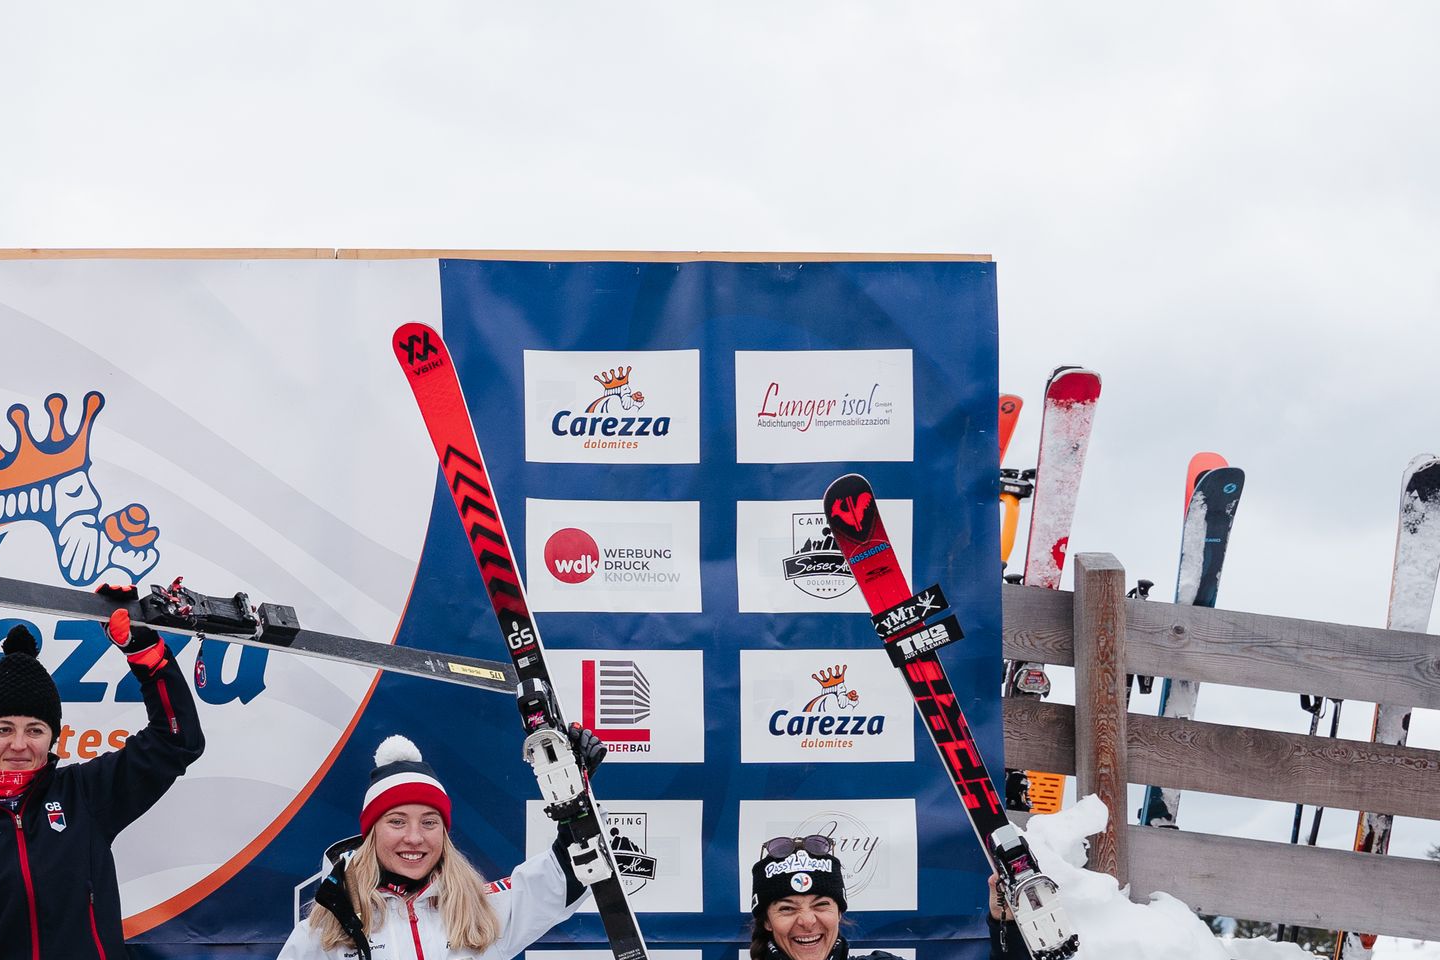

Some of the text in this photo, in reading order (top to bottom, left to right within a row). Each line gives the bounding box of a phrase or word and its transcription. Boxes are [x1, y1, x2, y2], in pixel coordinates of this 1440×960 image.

[758, 382, 836, 433] Lunger
[842, 383, 880, 415] isol
[551, 410, 671, 438] Carezza
[757, 417, 891, 429] Abdichtungen Impermeabilizzazioni
[584, 440, 639, 449] dolomites
[603, 549, 672, 559] WERBUNG
[848, 542, 891, 565] ROSSIGNOL
[554, 555, 600, 575] wdk
[603, 561, 650, 571] DRUCK
[603, 572, 681, 583] KNOWHOW
[806, 579, 846, 587] DOLOMITES
[508, 627, 534, 650] GS
[768, 710, 885, 737] Carezza
[801, 739, 854, 749] dolomites
[44, 802, 62, 812] GB
[605, 817, 643, 826] MPING
